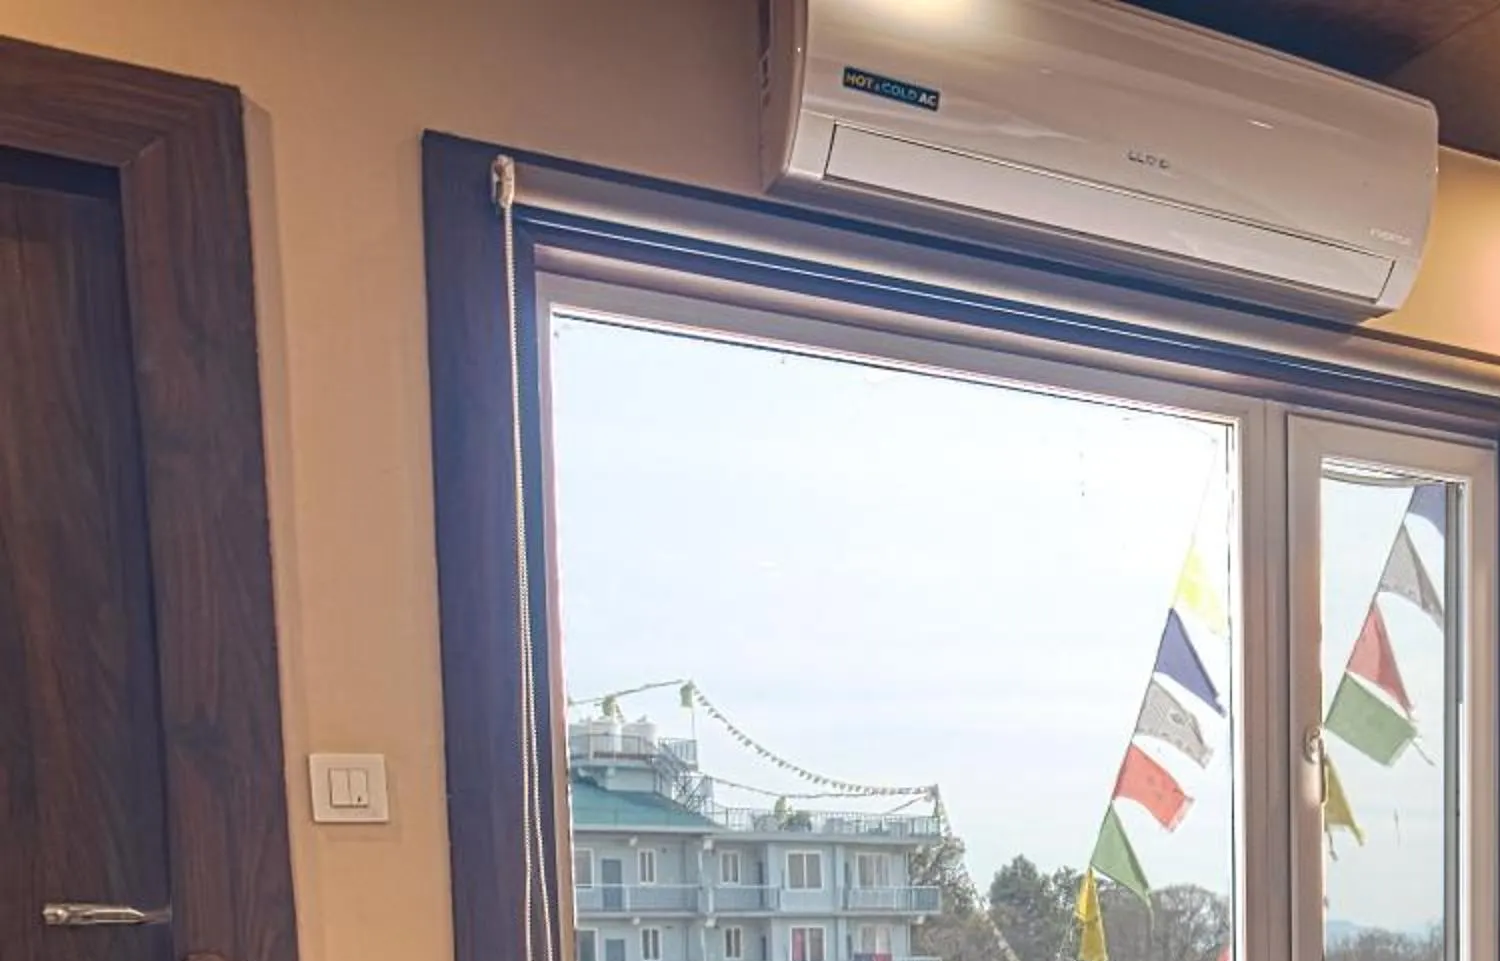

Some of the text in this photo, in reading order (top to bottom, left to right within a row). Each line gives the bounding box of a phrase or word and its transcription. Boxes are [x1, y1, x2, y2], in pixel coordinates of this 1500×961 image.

[846, 72, 873, 88] HOT
[882, 83, 917, 100] COLD
[918, 93, 937, 106] AC
